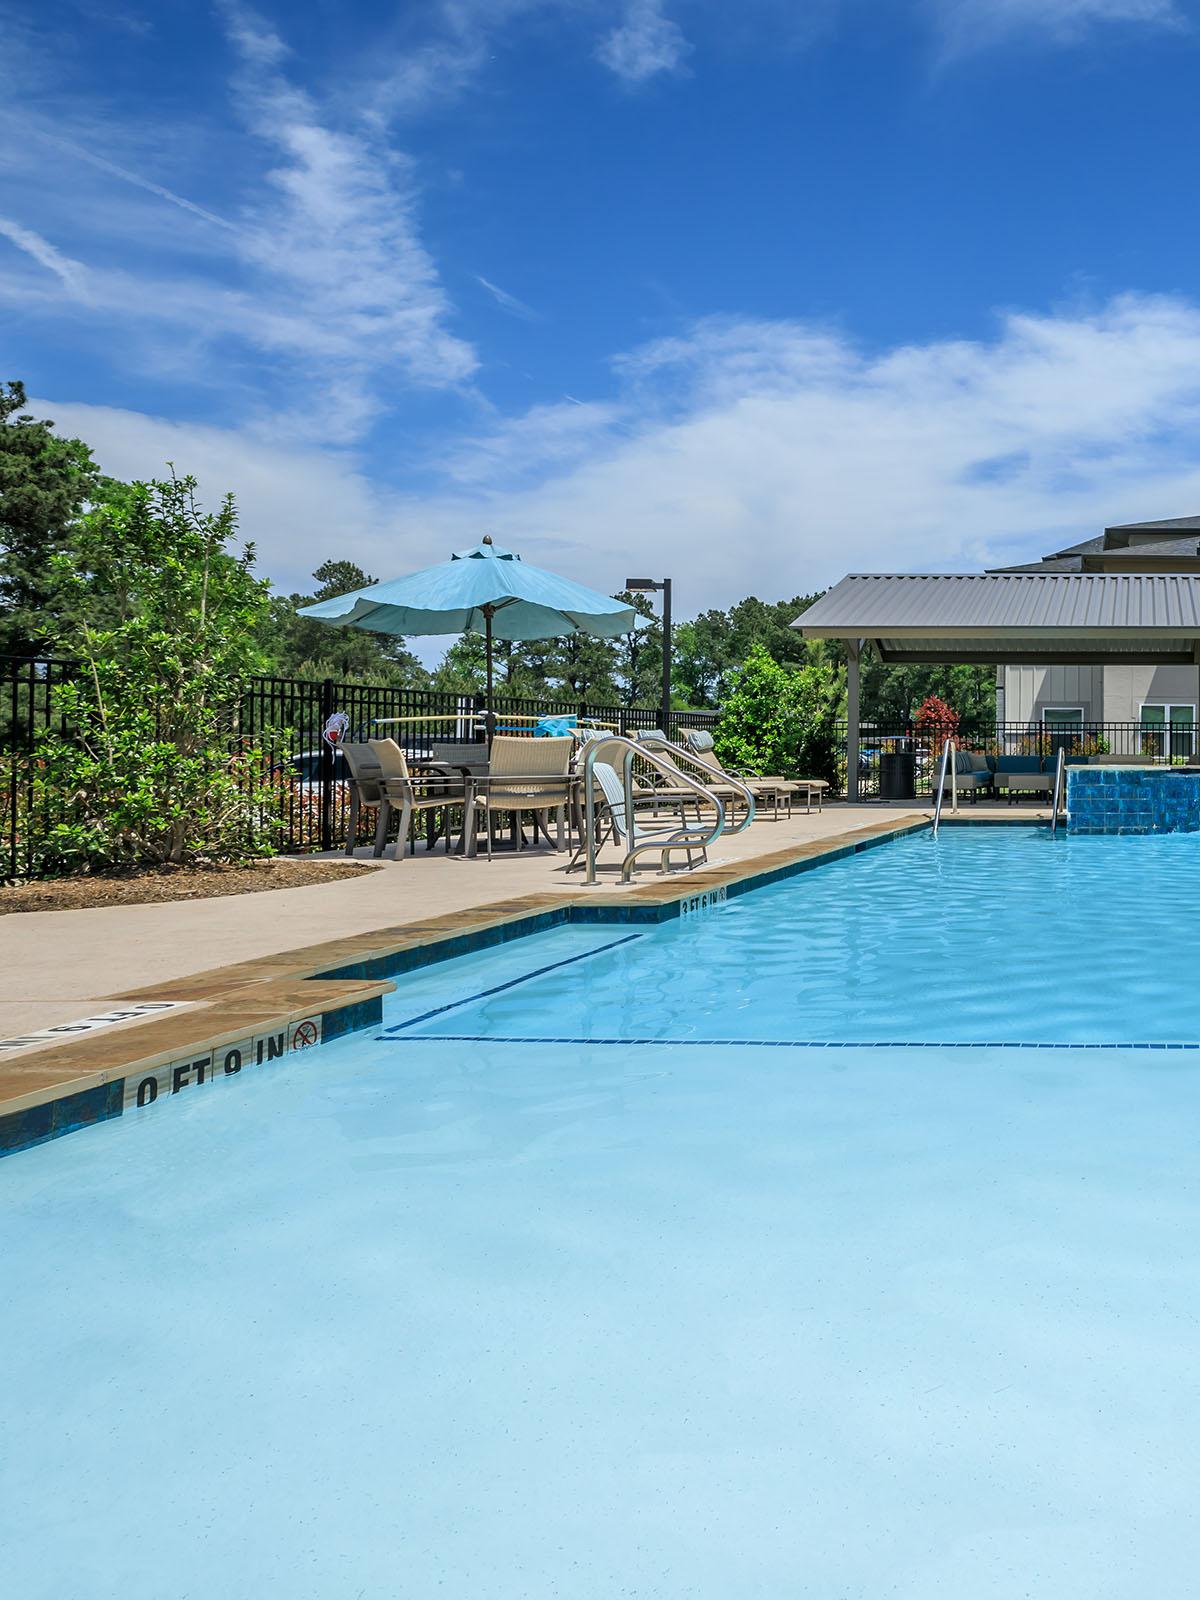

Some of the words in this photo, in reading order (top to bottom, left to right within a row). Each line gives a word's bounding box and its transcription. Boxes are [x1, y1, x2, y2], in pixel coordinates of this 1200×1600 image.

[172, 1056, 211, 1095] FT
[223, 1049, 242, 1077] 9
[256, 1032, 285, 1066] IN
